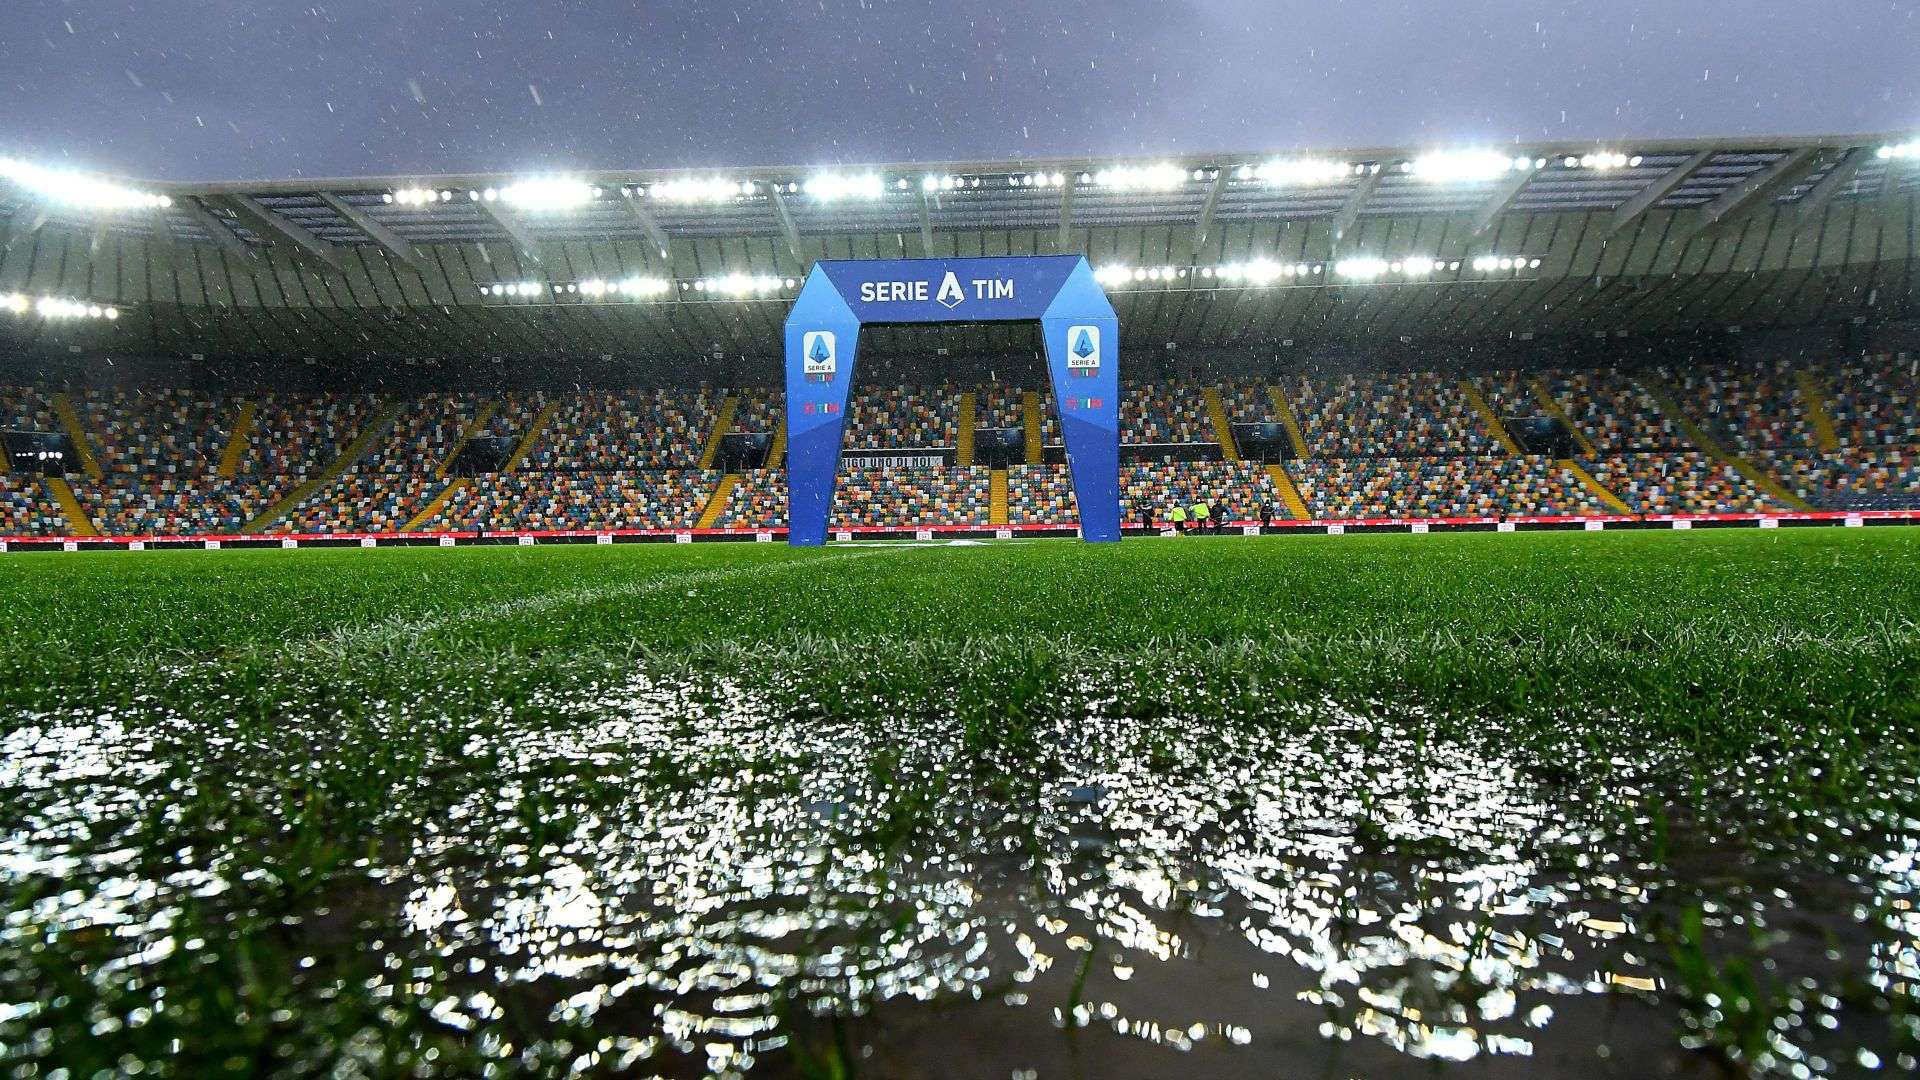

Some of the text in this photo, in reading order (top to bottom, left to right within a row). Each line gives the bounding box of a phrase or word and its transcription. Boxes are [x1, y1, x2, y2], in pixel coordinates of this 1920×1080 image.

[860, 271, 1014, 303] SERIE A TIM
[896, 457, 908, 467] DI
